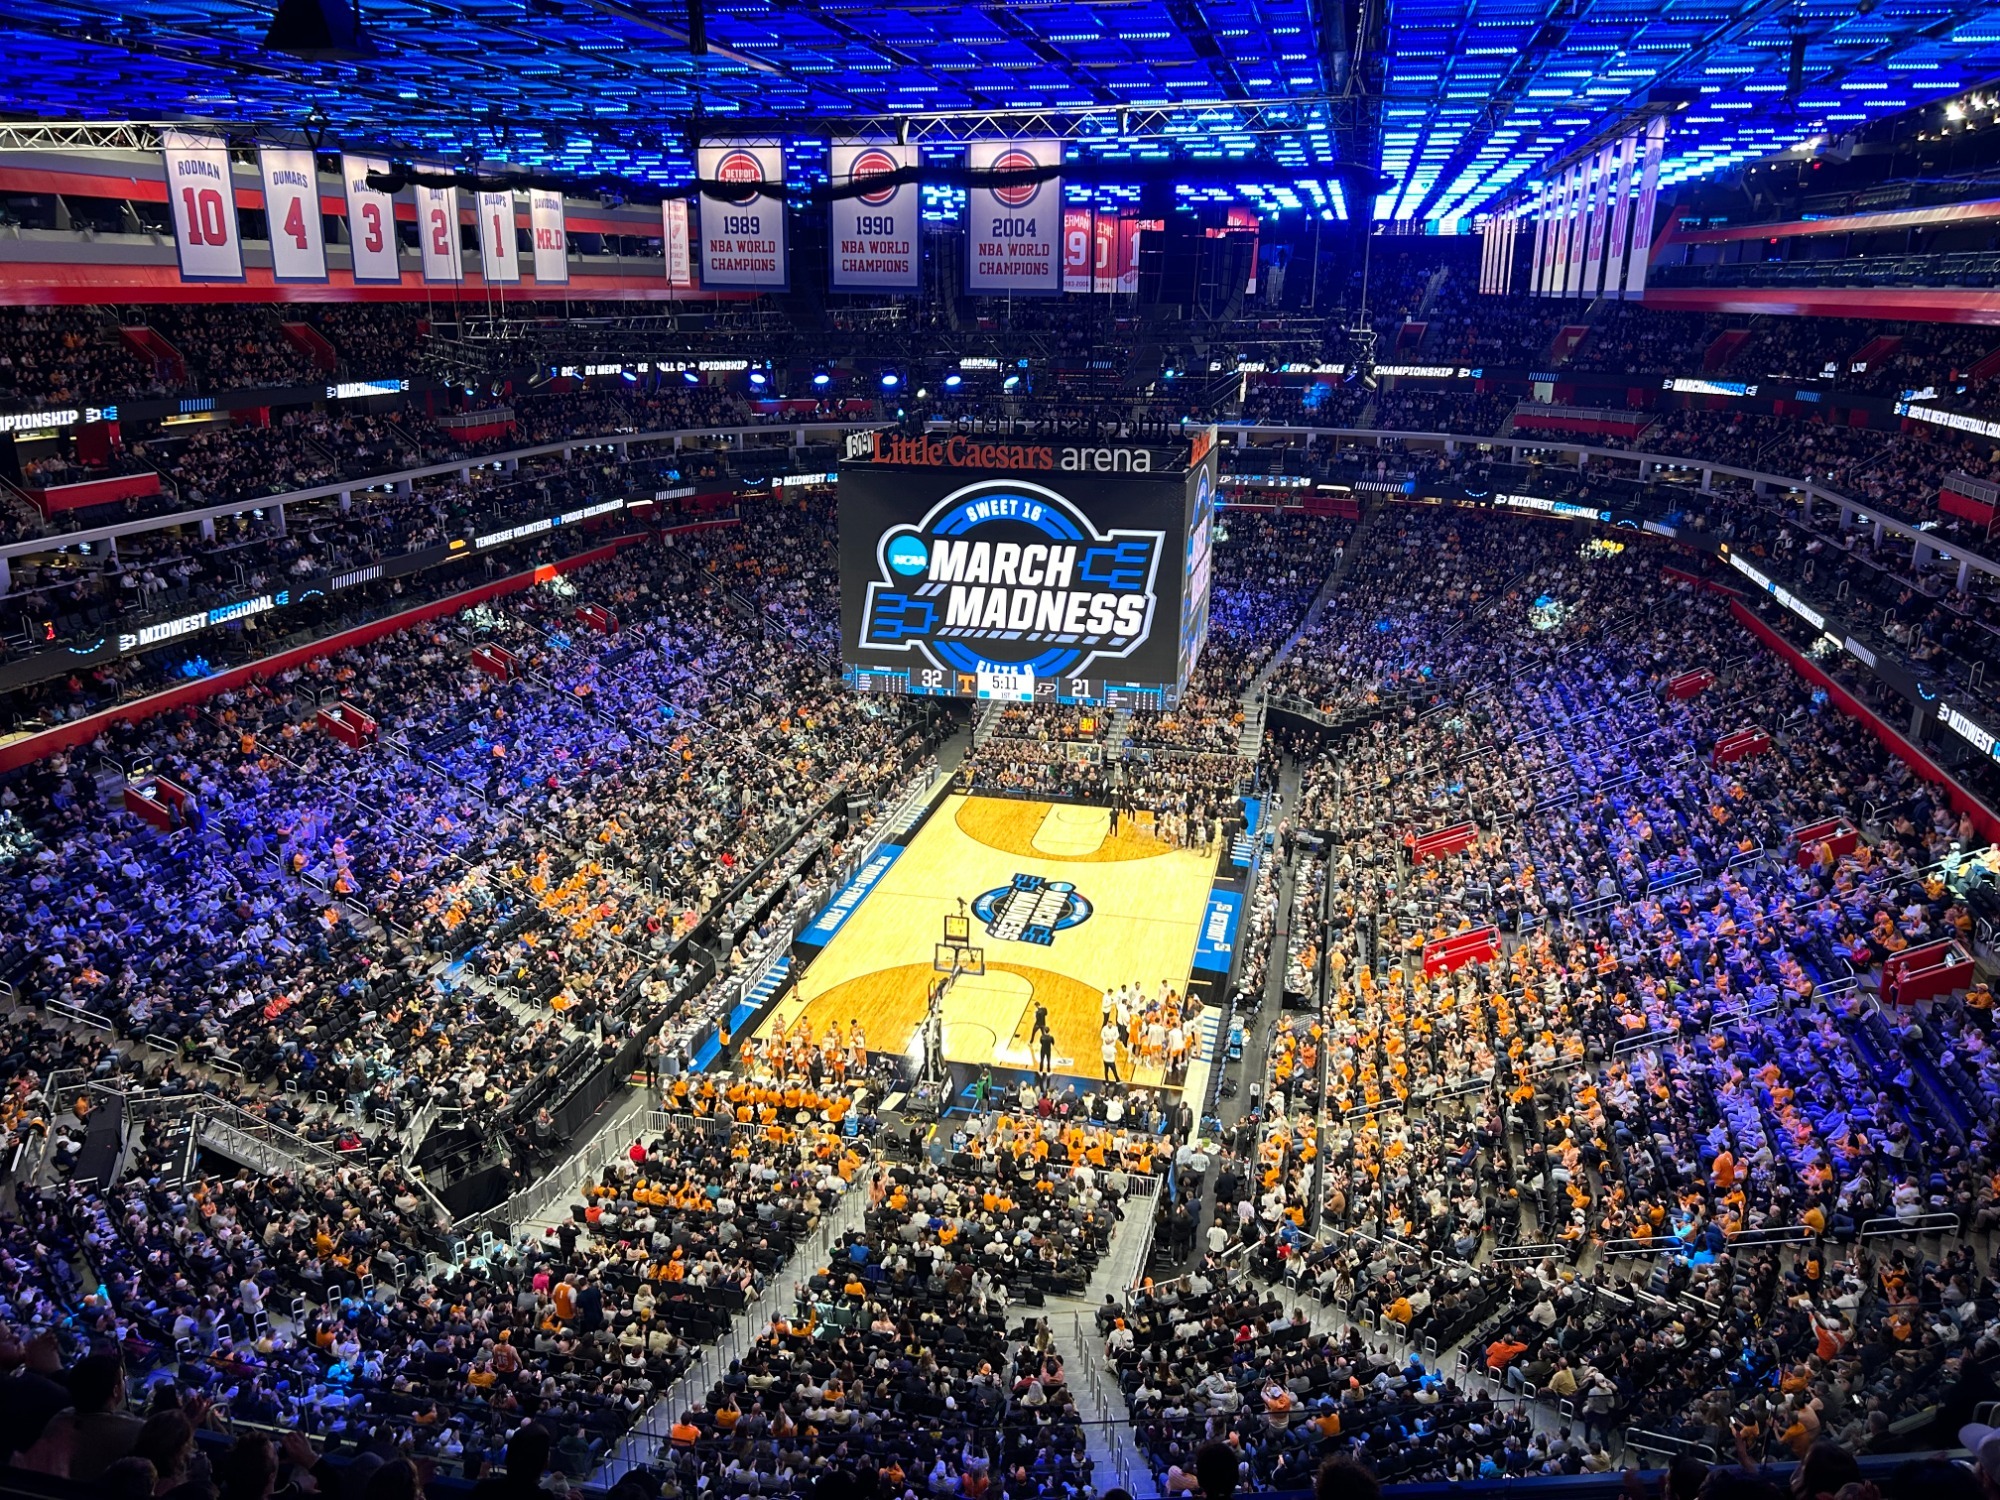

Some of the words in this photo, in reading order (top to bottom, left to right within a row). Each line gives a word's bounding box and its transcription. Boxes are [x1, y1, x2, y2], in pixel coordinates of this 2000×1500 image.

[178, 160, 220, 180] RODMAN
[273, 171, 308, 188] DUMARS
[725, 168, 755, 178] DETROIT
[484, 194, 506, 208] BILLUPS
[182, 187, 227, 246] 10
[284, 197, 308, 249] 4
[724, 216, 760, 234] 1989
[857, 216, 893, 235] 1990
[362, 203, 384, 252] 3
[431, 209, 449, 255] 2
[493, 214, 504, 257] 1
[993, 218, 1036, 237] 2004
[710, 240, 733, 252] NBA
[737, 240, 775, 253] WORLD
[841, 241, 865, 253] NBA
[869, 241, 909, 254] WORLD
[979, 243, 1003, 256] NBA
[1009, 243, 1049, 256] WORLD
[711, 258, 775, 271] CHAMPIONS
[842, 259, 908, 272] CHAMPIONS
[979, 262, 1048, 275] CHAMPIONS
[1239, 363, 1264, 372] 2024
[1374, 366, 1453, 377] CHAMPIONSHIP
[872, 433, 943, 466] Little
[947, 435, 1053, 469] Caesars
[1060, 447, 1151, 472] arena
[784, 473, 826, 486] MIDWEST
[966, 499, 1018, 522] SWEET
[1022, 502, 1042, 522] 16
[1508, 495, 1555, 511] MIDWEST
[1554, 502, 1599, 519] REGIONAL
[475, 530, 513, 548] TENNESSEE
[514, 519, 552, 537] VOLUNTEERS
[892, 554, 927, 567] NCAA
[928, 540, 1077, 588] MARCH
[139, 612, 208, 645] MIDWEST
[209, 595, 274, 625] REGIONAL
[945, 587, 1146, 636] MADNESS
[922, 668, 943, 688] 32
[992, 675, 1018, 690] 5:11
[1071, 679, 1091, 698] 21
[1948, 709, 1996, 755] MIDWEST
[833, 886, 865, 908] FINAL
[993, 890, 1041, 941] MADNESS
[1029, 889, 1068, 928] MARCH
[814, 907, 848, 931] FOUR
